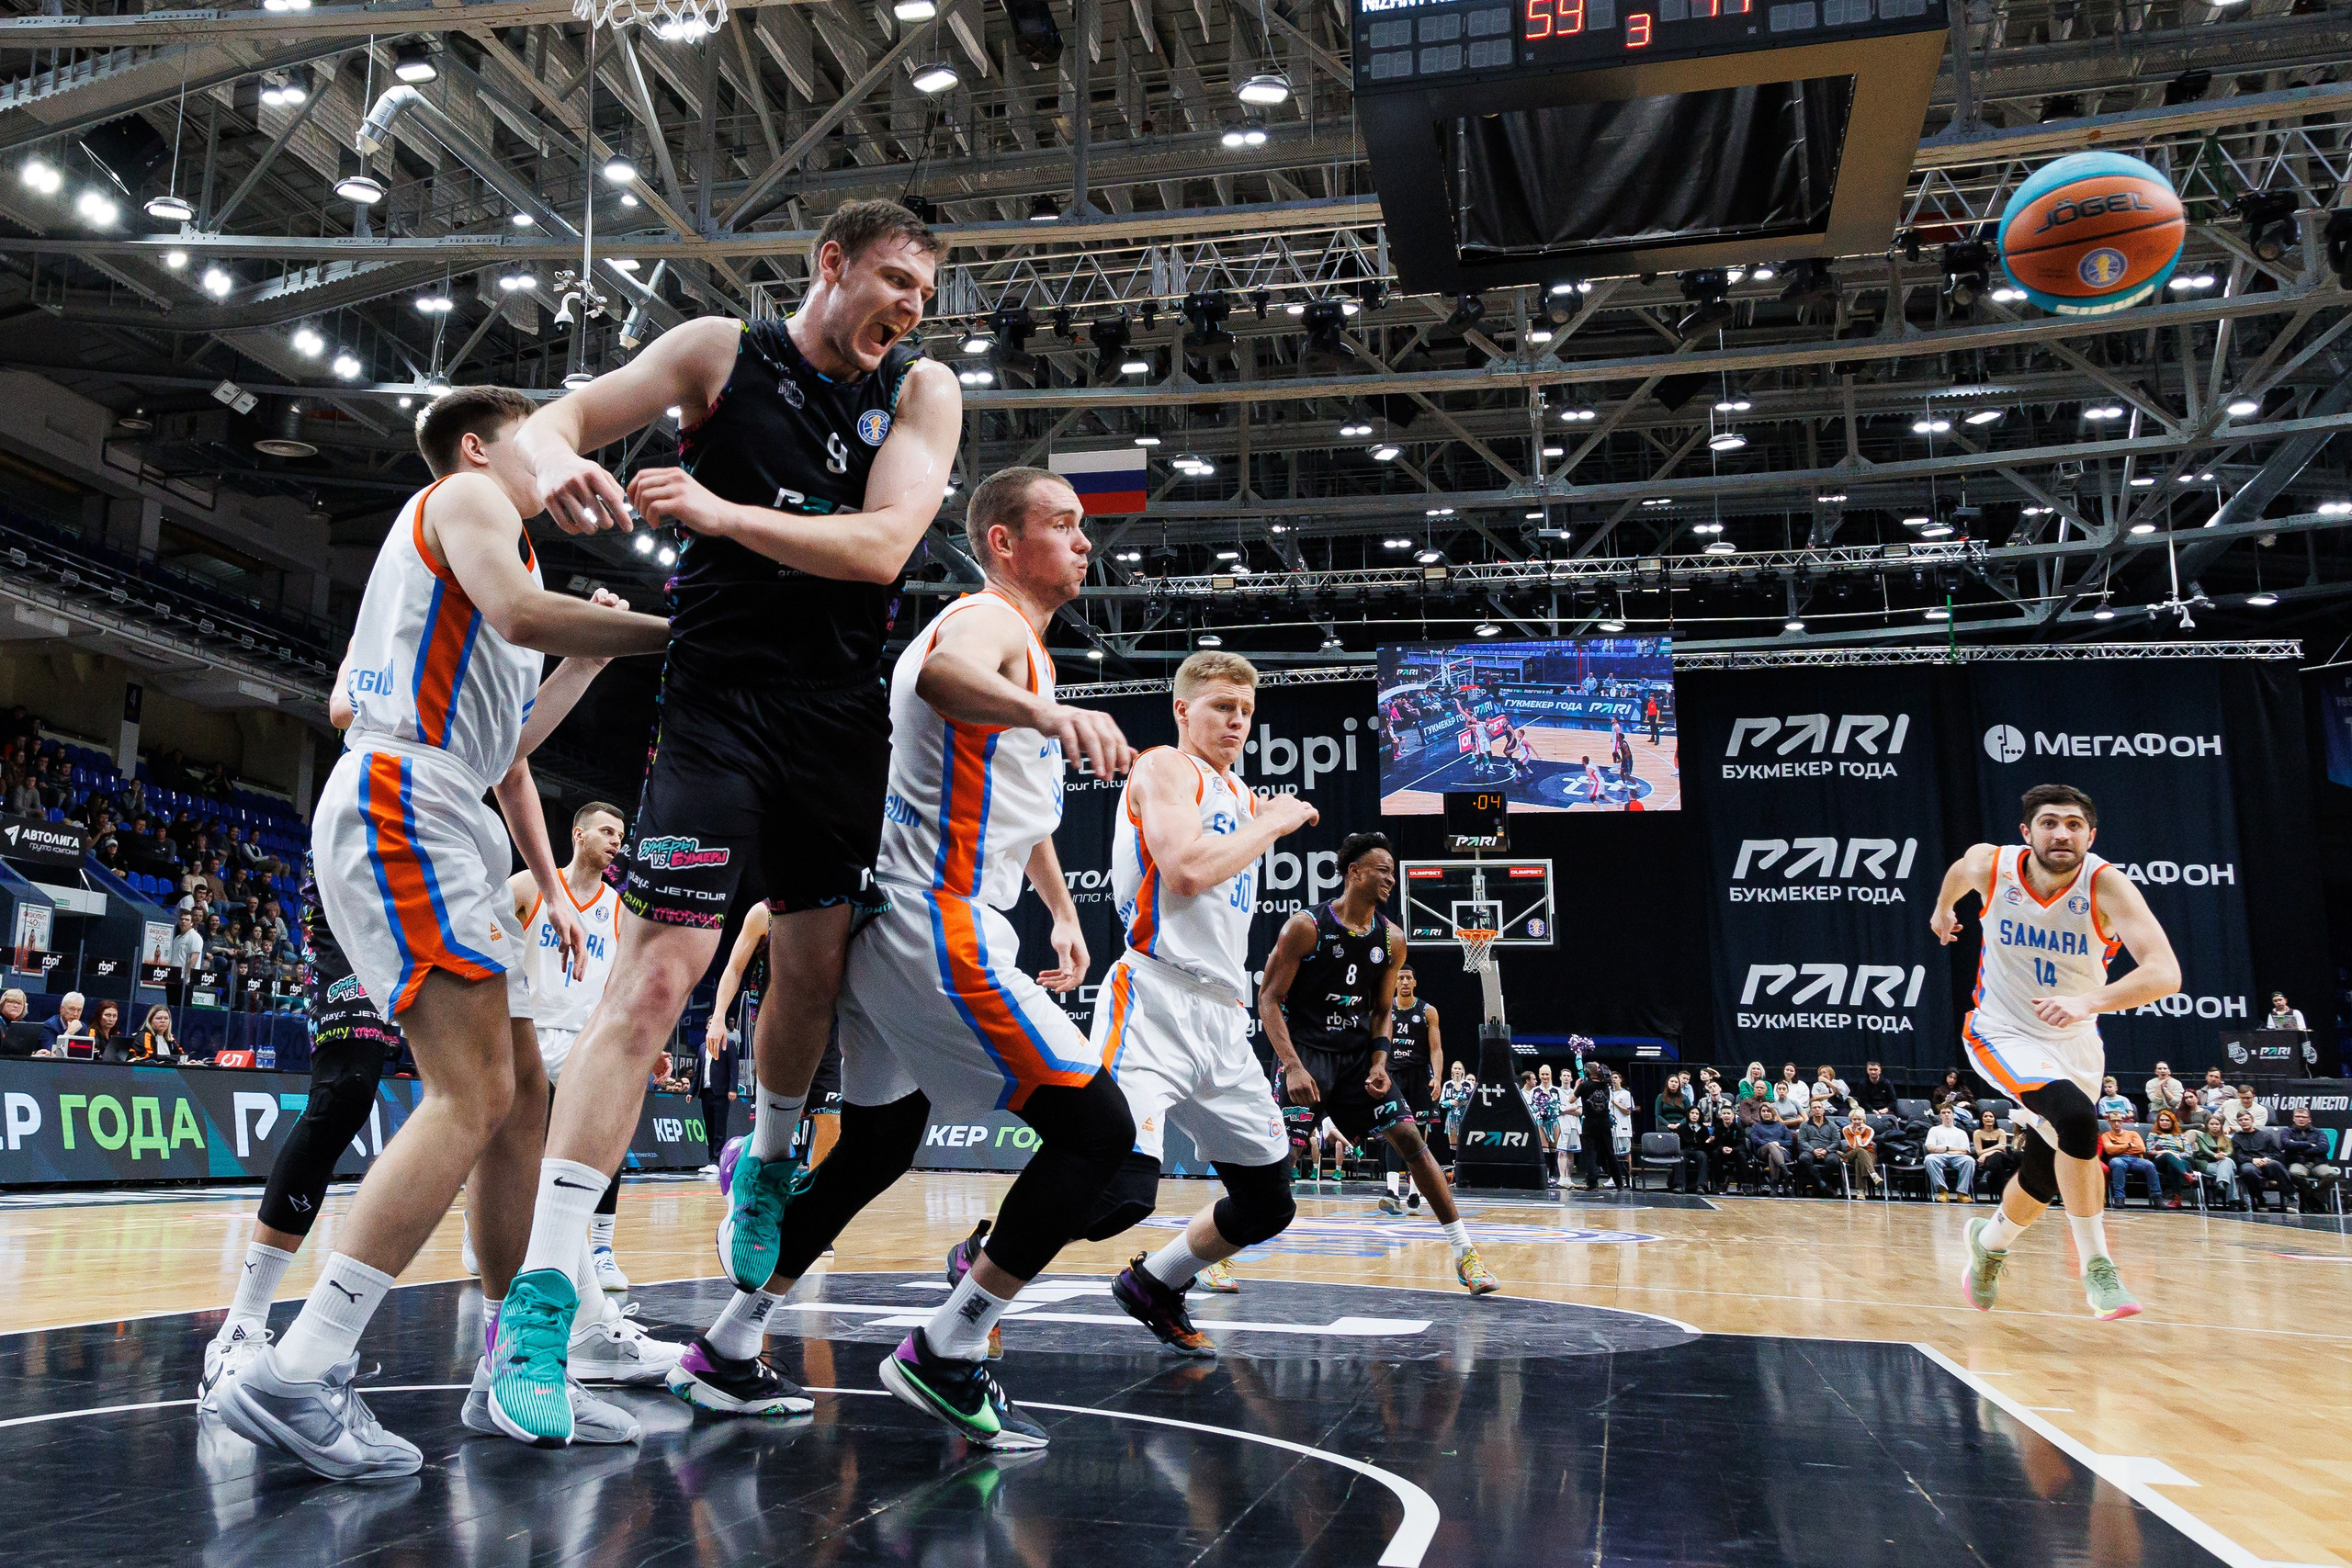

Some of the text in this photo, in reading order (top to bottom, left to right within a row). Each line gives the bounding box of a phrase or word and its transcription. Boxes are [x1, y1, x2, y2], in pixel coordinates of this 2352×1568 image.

[1526, 0, 1583, 39] 59
[1626, 14, 1651, 46] 3
[2034, 191, 2153, 235] JÖGEL
[827, 432, 848, 474] 9
[1473, 700, 1493, 717] PARI
[1555, 701, 1582, 711] ГОДА
[1589, 702, 1632, 715] PARI
[1725, 713, 1910, 757] PARI
[2033, 731, 2222, 758] МЕГАФОН
[1722, 761, 1898, 780] БУКМЕКЕР ГОДА
[1250, 783, 1298, 797] roup
[21, 829, 80, 849] АВТОЛИГА
[29, 842, 51, 852] группа
[1455, 836, 1498, 847] PARI
[640, 840, 696, 862] ЗУМЕРЫ
[653, 852, 665, 866] VS
[1732, 837, 1918, 879] PARI
[2111, 861, 2235, 886] АФОН
[655, 886, 726, 901] JETOUR
[1729, 886, 1906, 905] БУКМЕКЕР ГОДА
[1255, 899, 1302, 916] roup
[539, 923, 605, 962] SARA
[1999, 919, 2089, 955] SAMARA
[1345, 964, 1358, 986] 8
[2033, 957, 2058, 987] 14
[1740, 963, 1926, 1009] PARI
[1325, 993, 1363, 1007] PARI
[1397, 1022, 1408, 1034] 24
[1737, 1012, 1914, 1033] БУКМЕКЕР ГОДА
[2259, 1046, 2291, 1055] PARI
[2311, 1096, 2349, 1111] МЕСТО
[0, 1093, 206, 1160] Р ГОДА
[652, 1118, 709, 1146] КЕР ГО
[925, 1124, 989, 1147] КЕР
[1466, 1131, 1529, 1147] PARI
